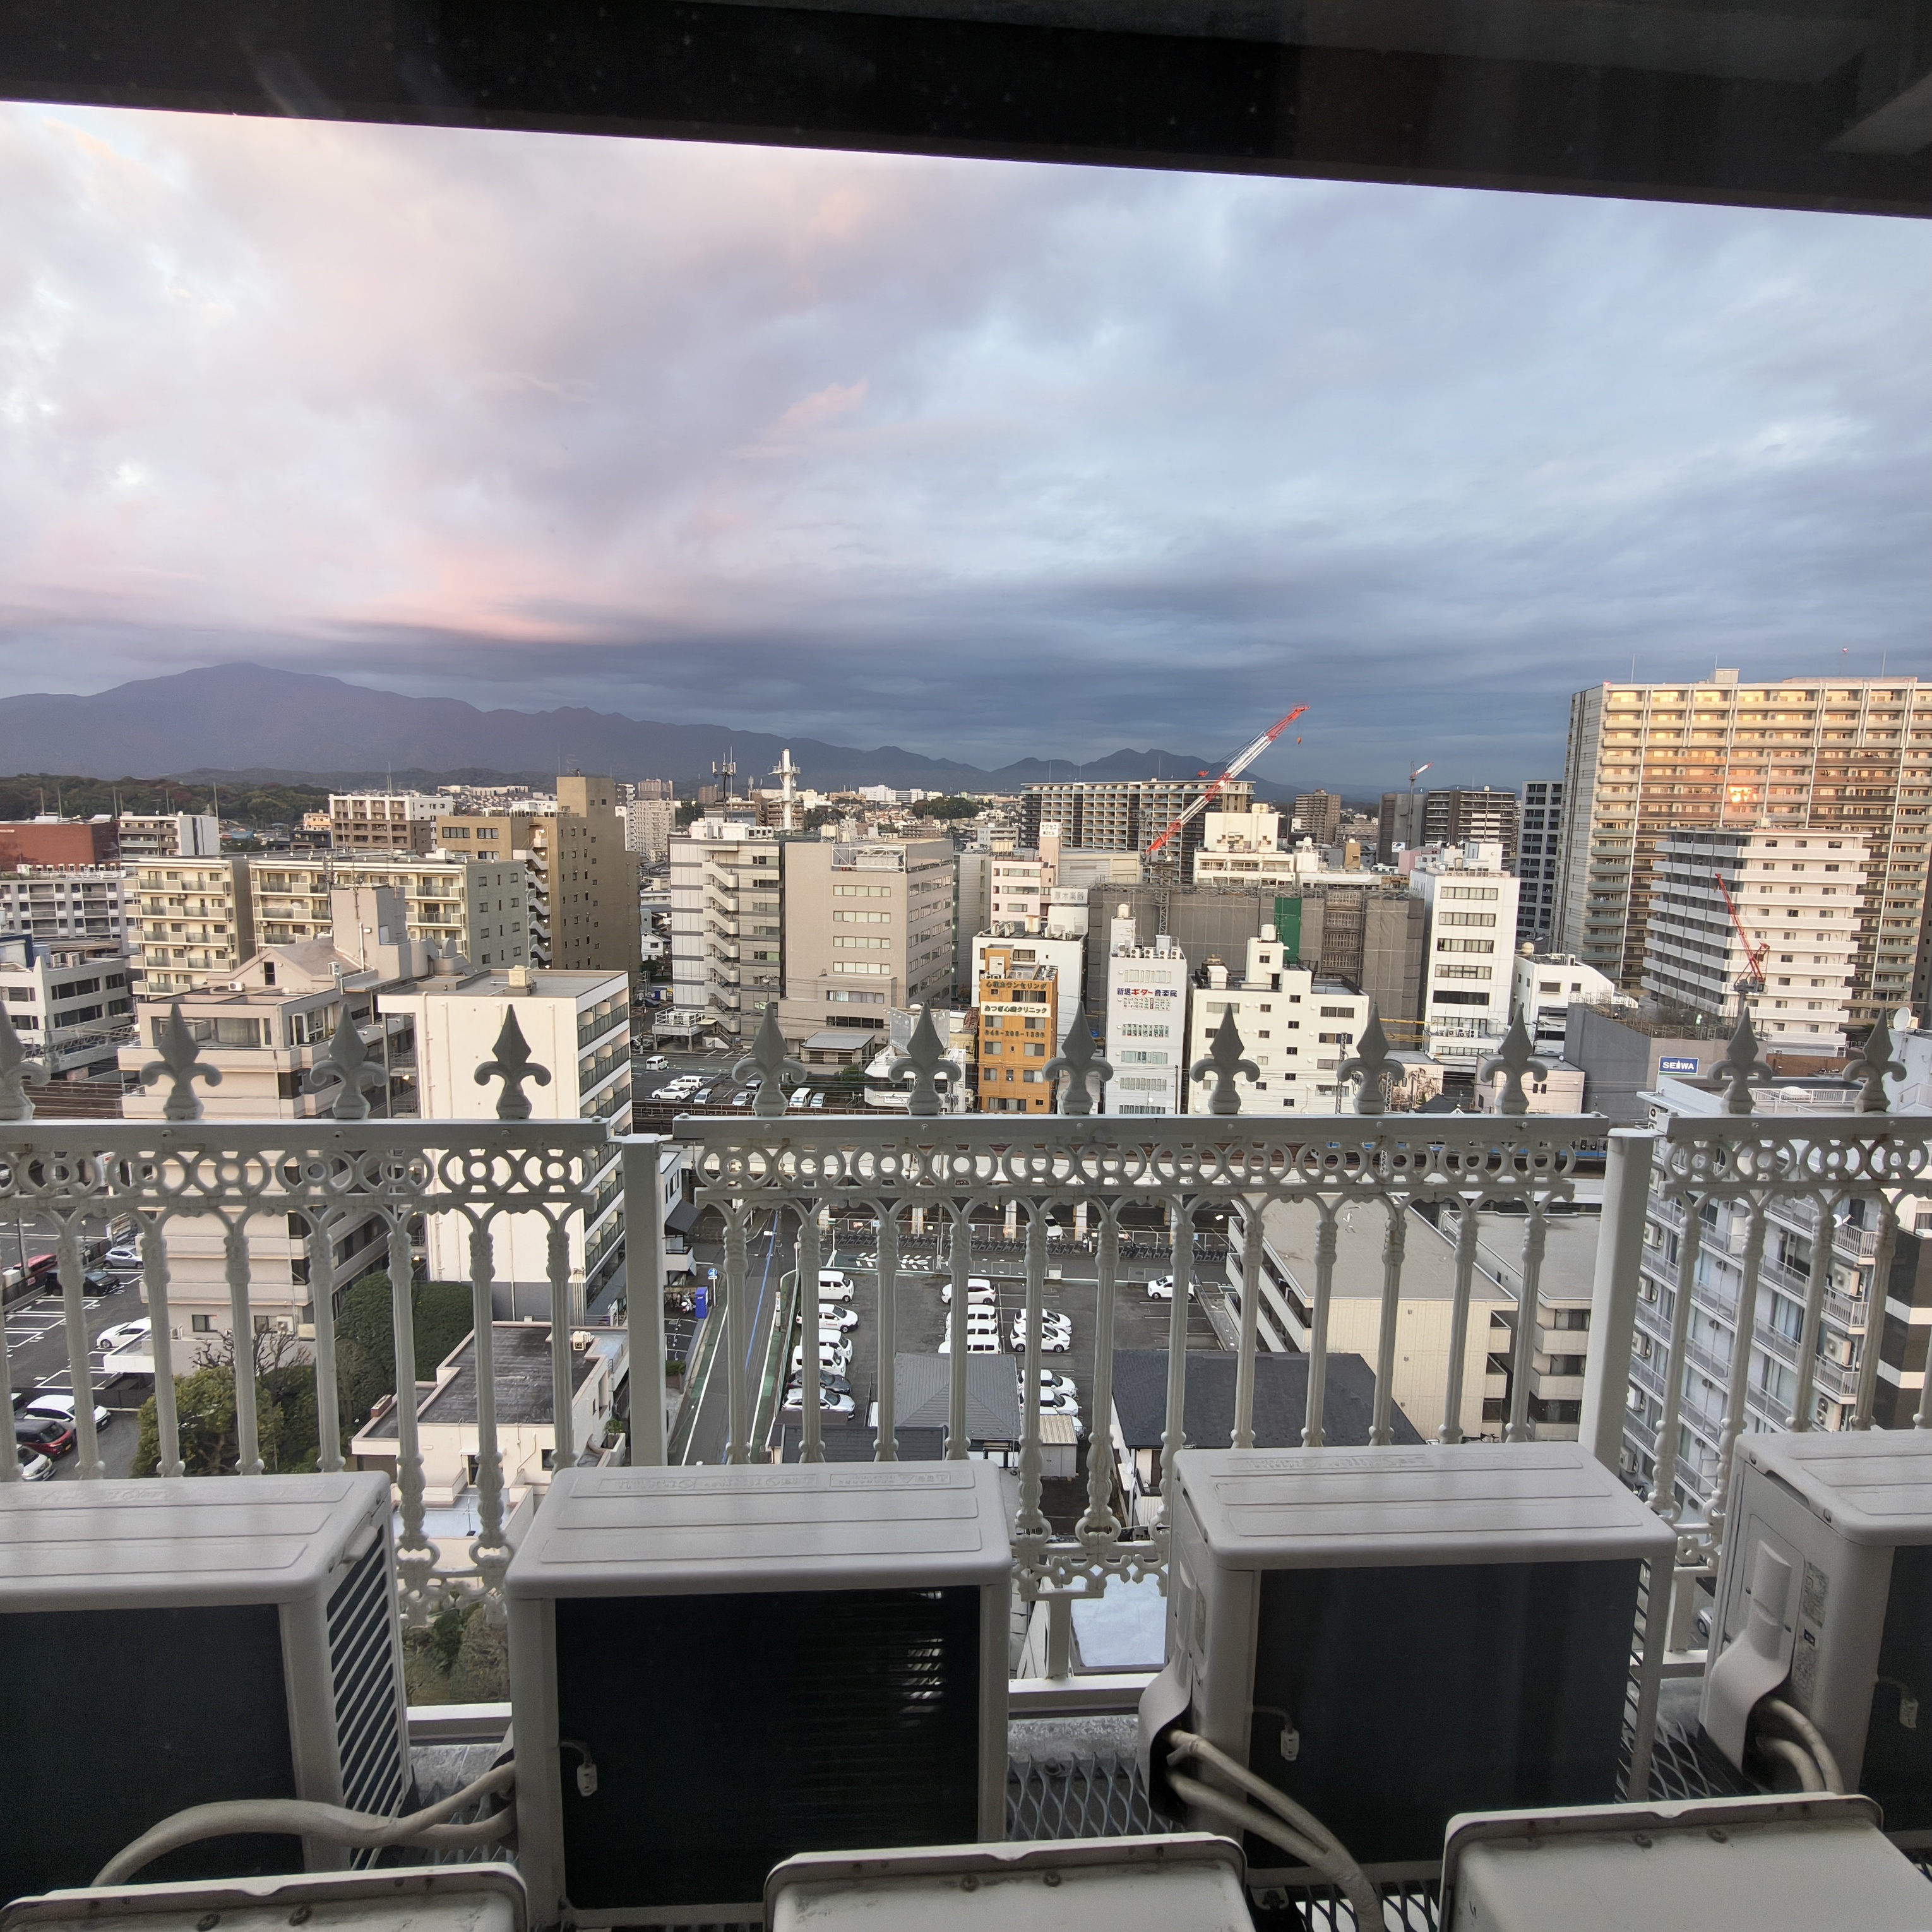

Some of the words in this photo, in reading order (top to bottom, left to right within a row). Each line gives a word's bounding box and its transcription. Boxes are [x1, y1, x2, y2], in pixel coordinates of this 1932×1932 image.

[1117, 987, 1178, 997] 新堀ギター音楽院
[1662, 1060, 1695, 1070] SEIWA
